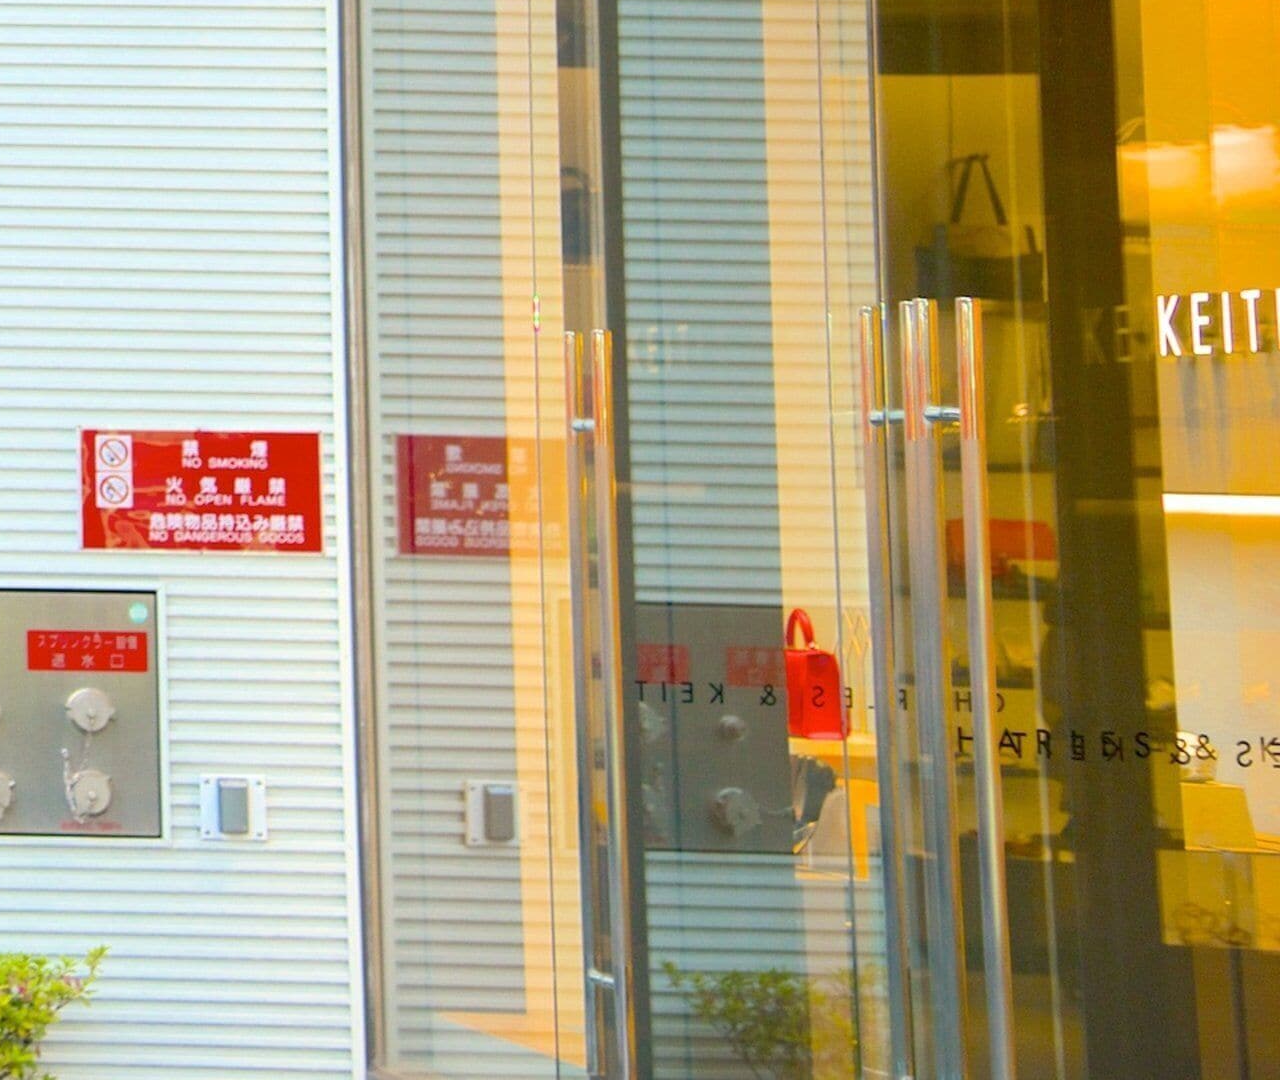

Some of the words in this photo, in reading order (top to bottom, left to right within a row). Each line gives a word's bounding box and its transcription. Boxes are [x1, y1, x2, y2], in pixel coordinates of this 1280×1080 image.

[1156, 287, 1280, 358] KEIT
[181, 457, 202, 469] NO
[208, 457, 269, 470] SMOKING
[164, 494, 186, 506] NO
[194, 495, 232, 506] OPEN
[240, 495, 287, 507] FLAME
[148, 529, 168, 542] NO
[174, 530, 253, 543] DANGEROUS
[258, 531, 305, 544] GOODS
